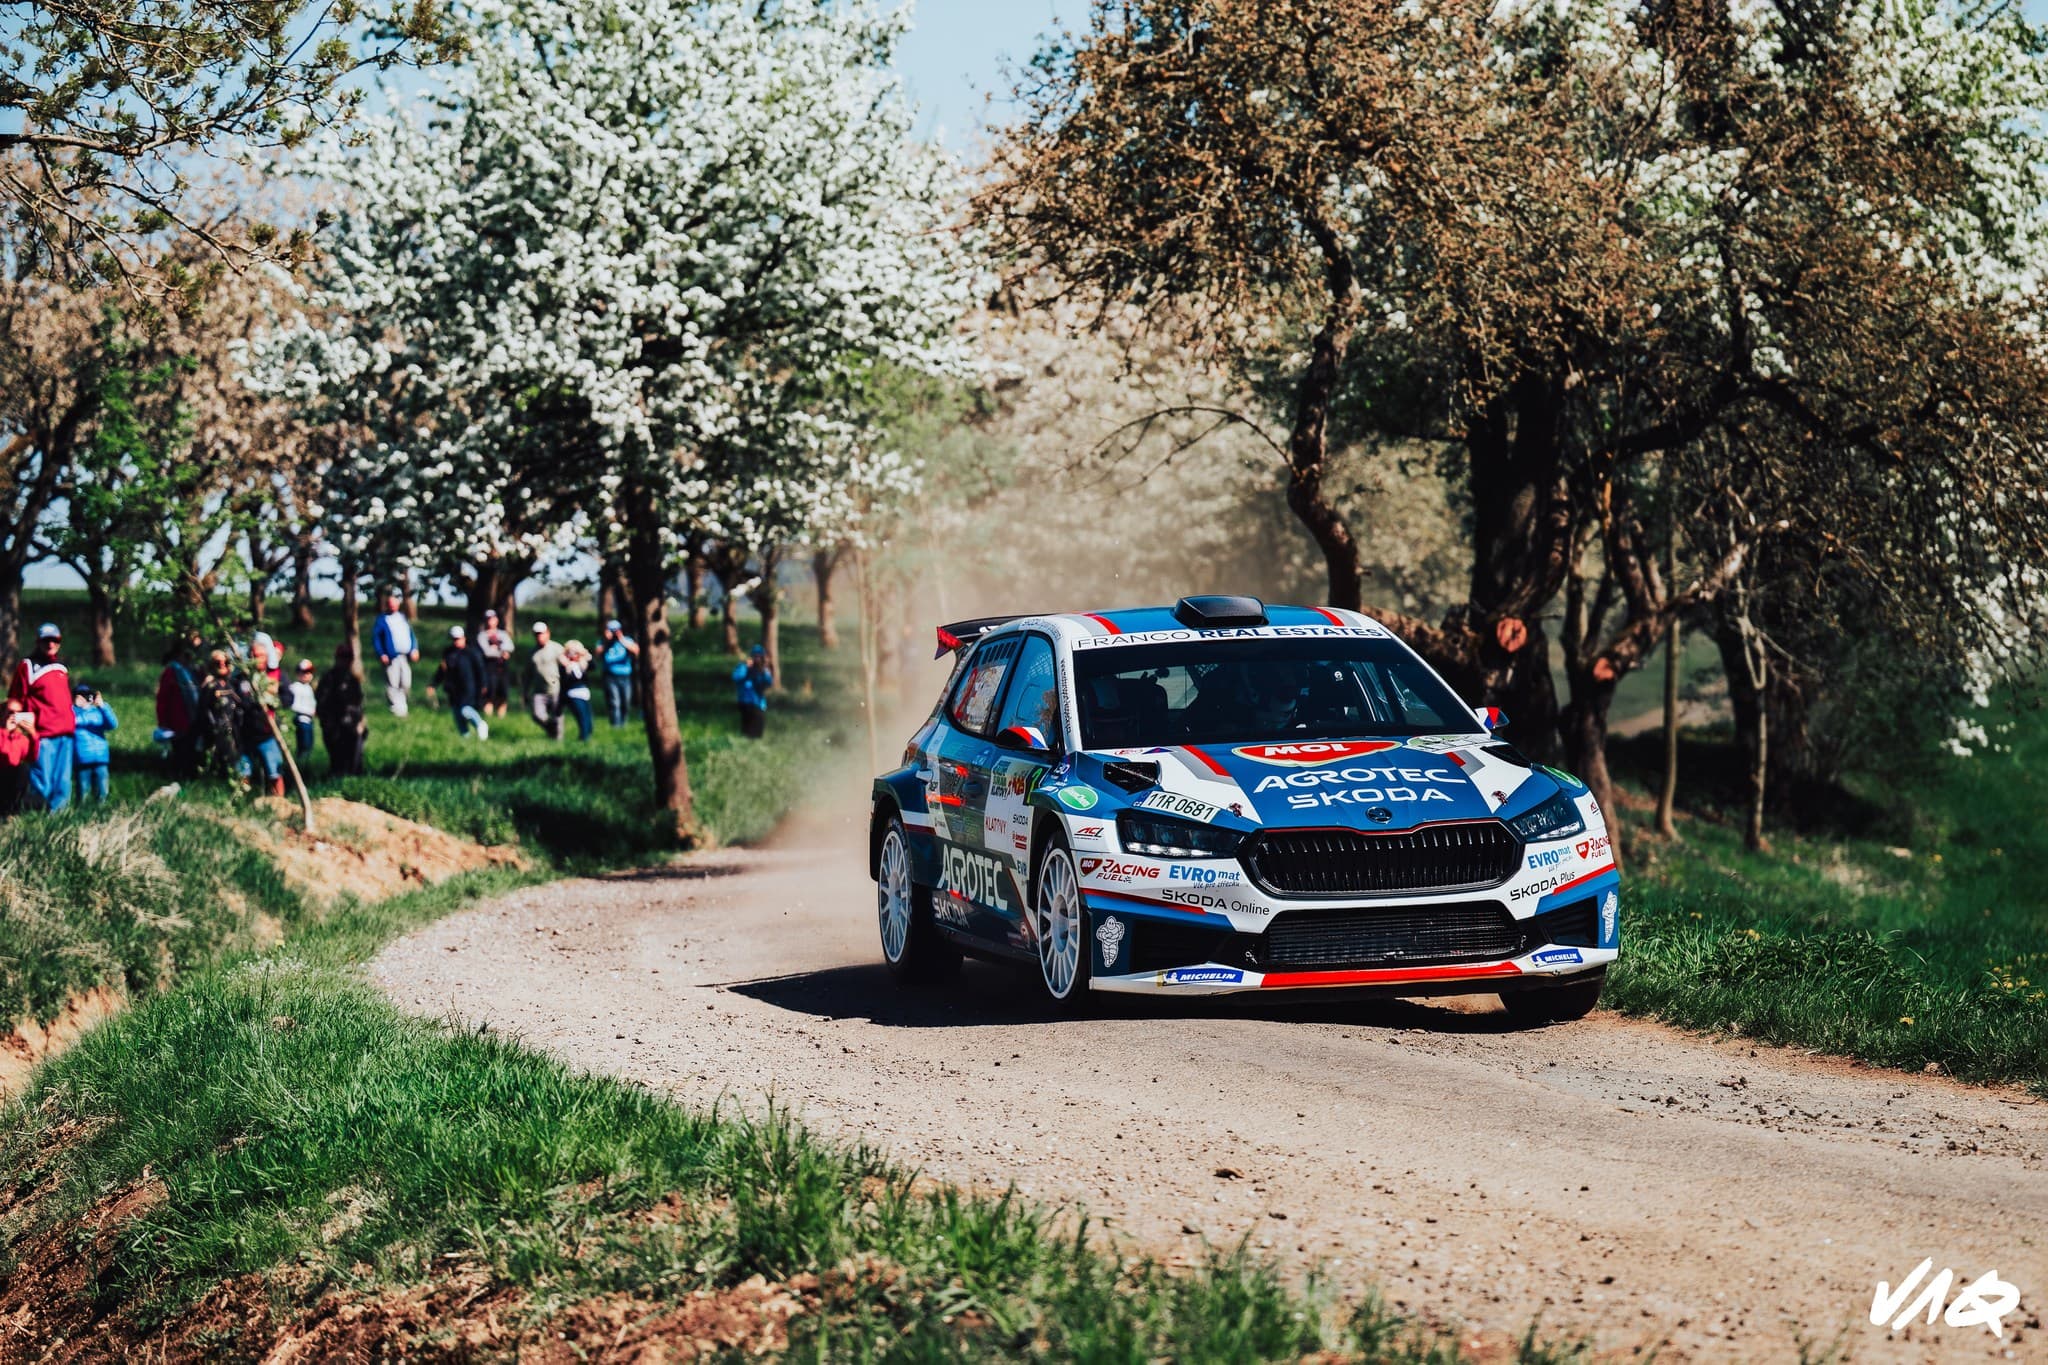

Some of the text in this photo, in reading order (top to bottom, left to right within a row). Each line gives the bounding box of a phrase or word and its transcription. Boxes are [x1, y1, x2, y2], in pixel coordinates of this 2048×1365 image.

[1078, 627, 1383, 648] FRANCO REAL ESTATES
[1264, 743, 1351, 757] MOL
[1253, 767, 1468, 793] AGROTEC
[1174, 798, 1214, 820] 0681
[936, 843, 1008, 911] AGROTEC
[1102, 859, 1160, 878] RACING
[1560, 871, 1576, 883] Plus
[1231, 900, 1270, 915] Online
[1180, 972, 1236, 981] MICHELIN
